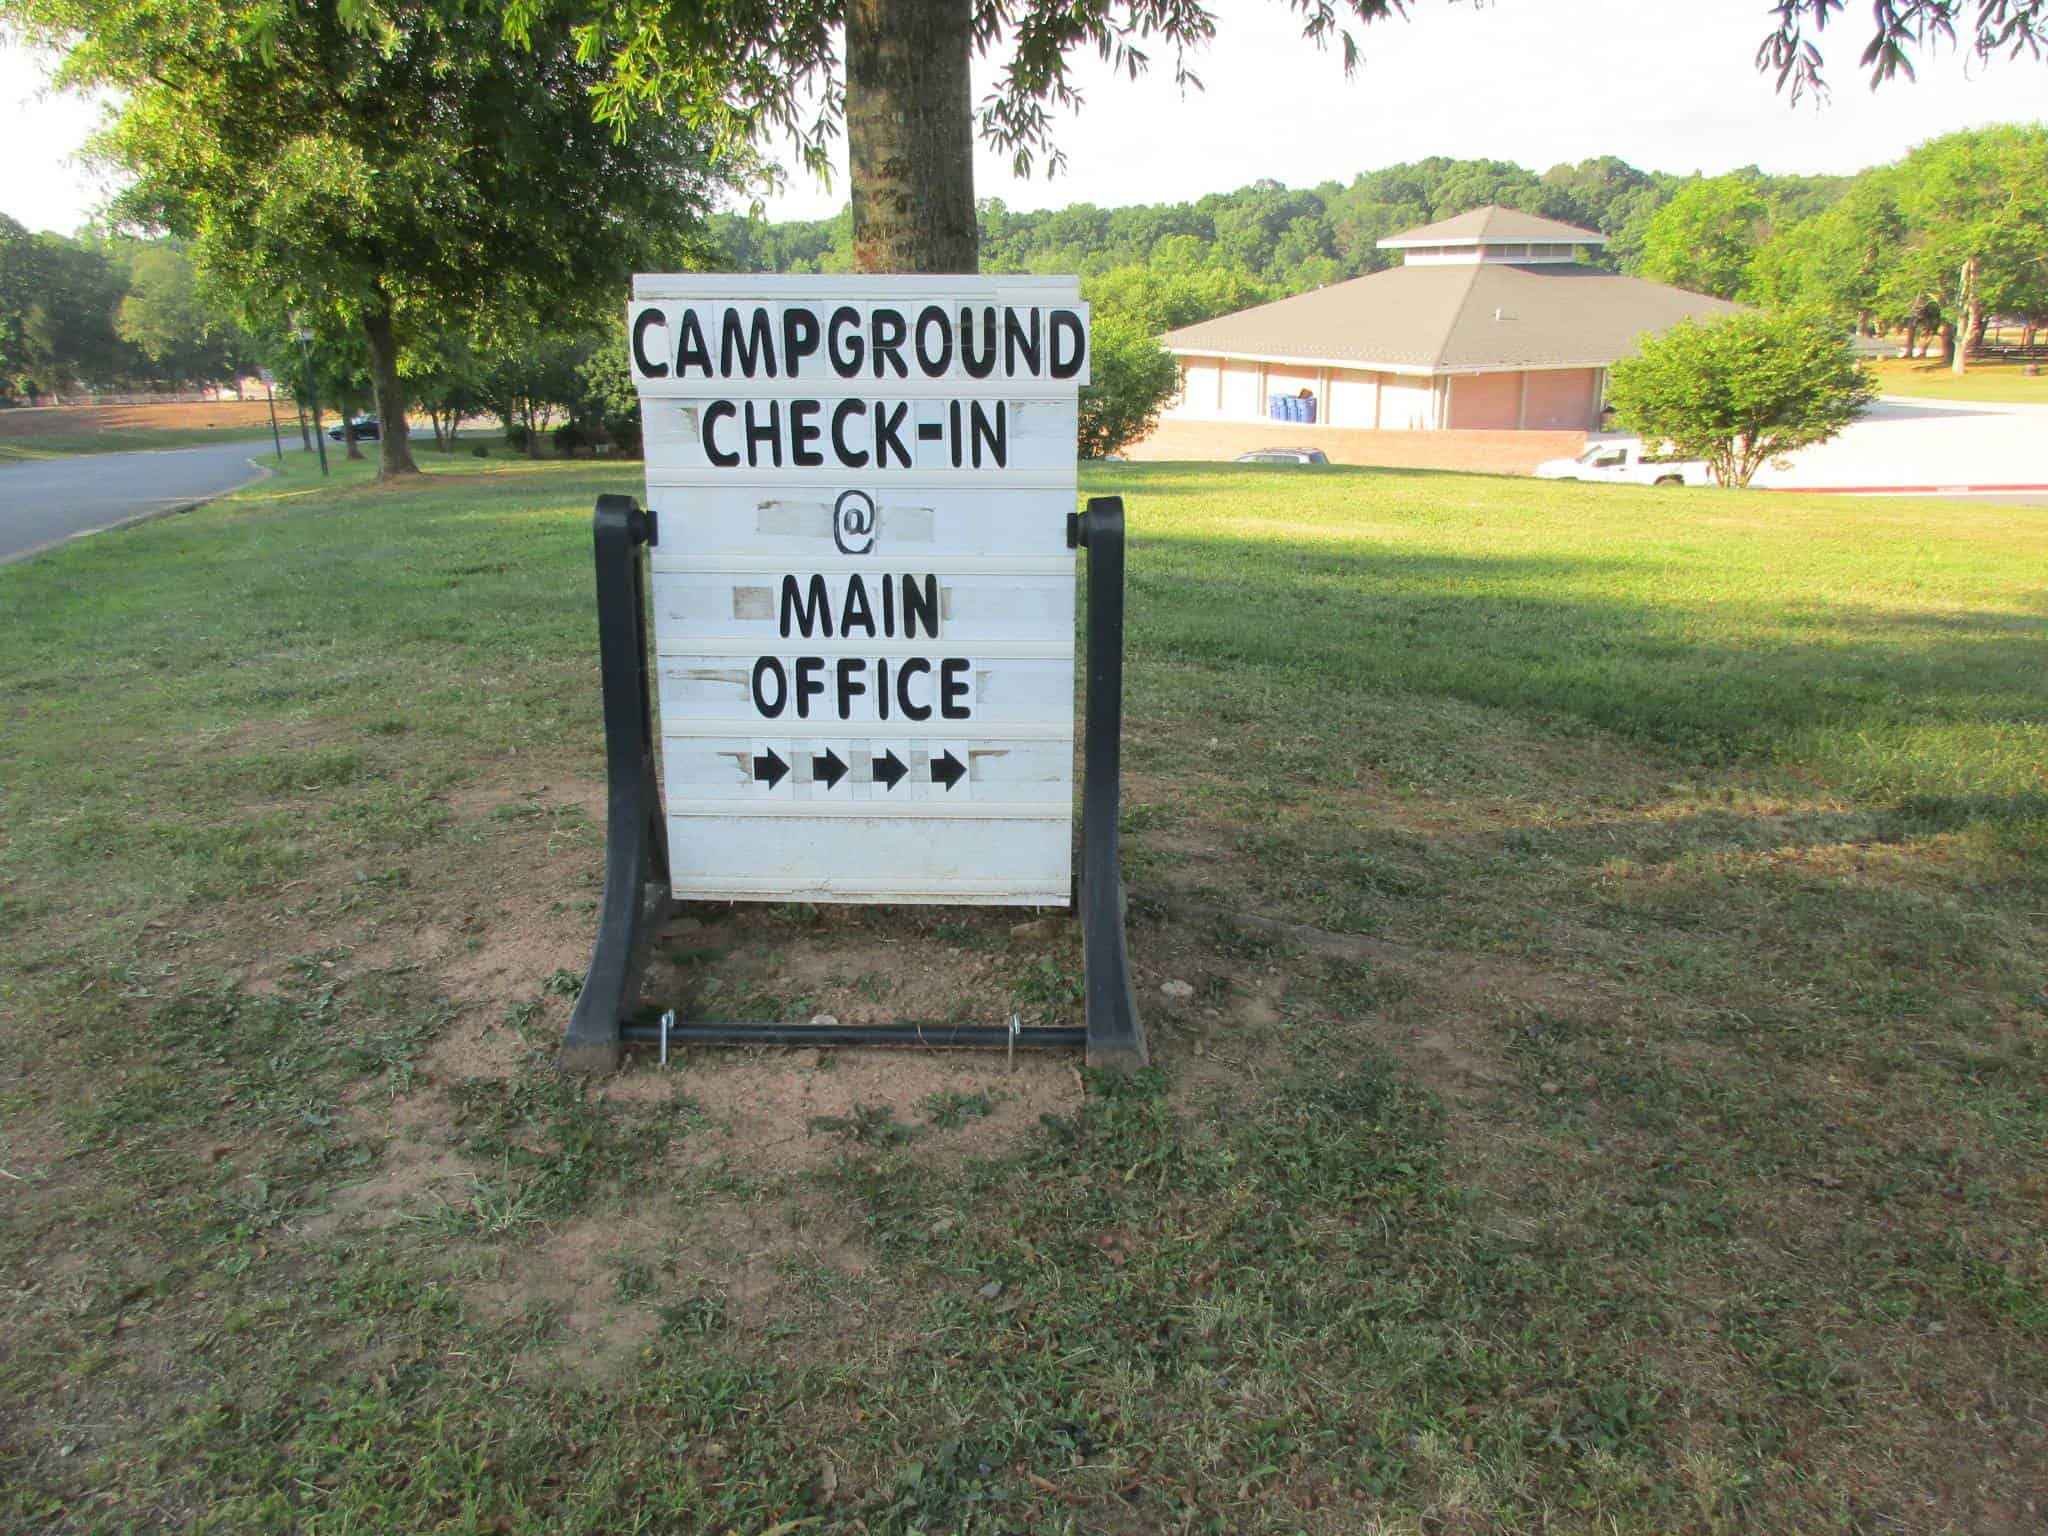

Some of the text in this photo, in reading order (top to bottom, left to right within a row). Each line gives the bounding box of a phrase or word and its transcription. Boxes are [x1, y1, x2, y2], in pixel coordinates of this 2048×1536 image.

[632, 305, 1085, 379] CAMPGROUND
[701, 398, 1007, 469] CHECK-IN
[832, 489, 876, 555] @
[778, 572, 940, 640] MAIN
[751, 654, 972, 721] OFFICE
